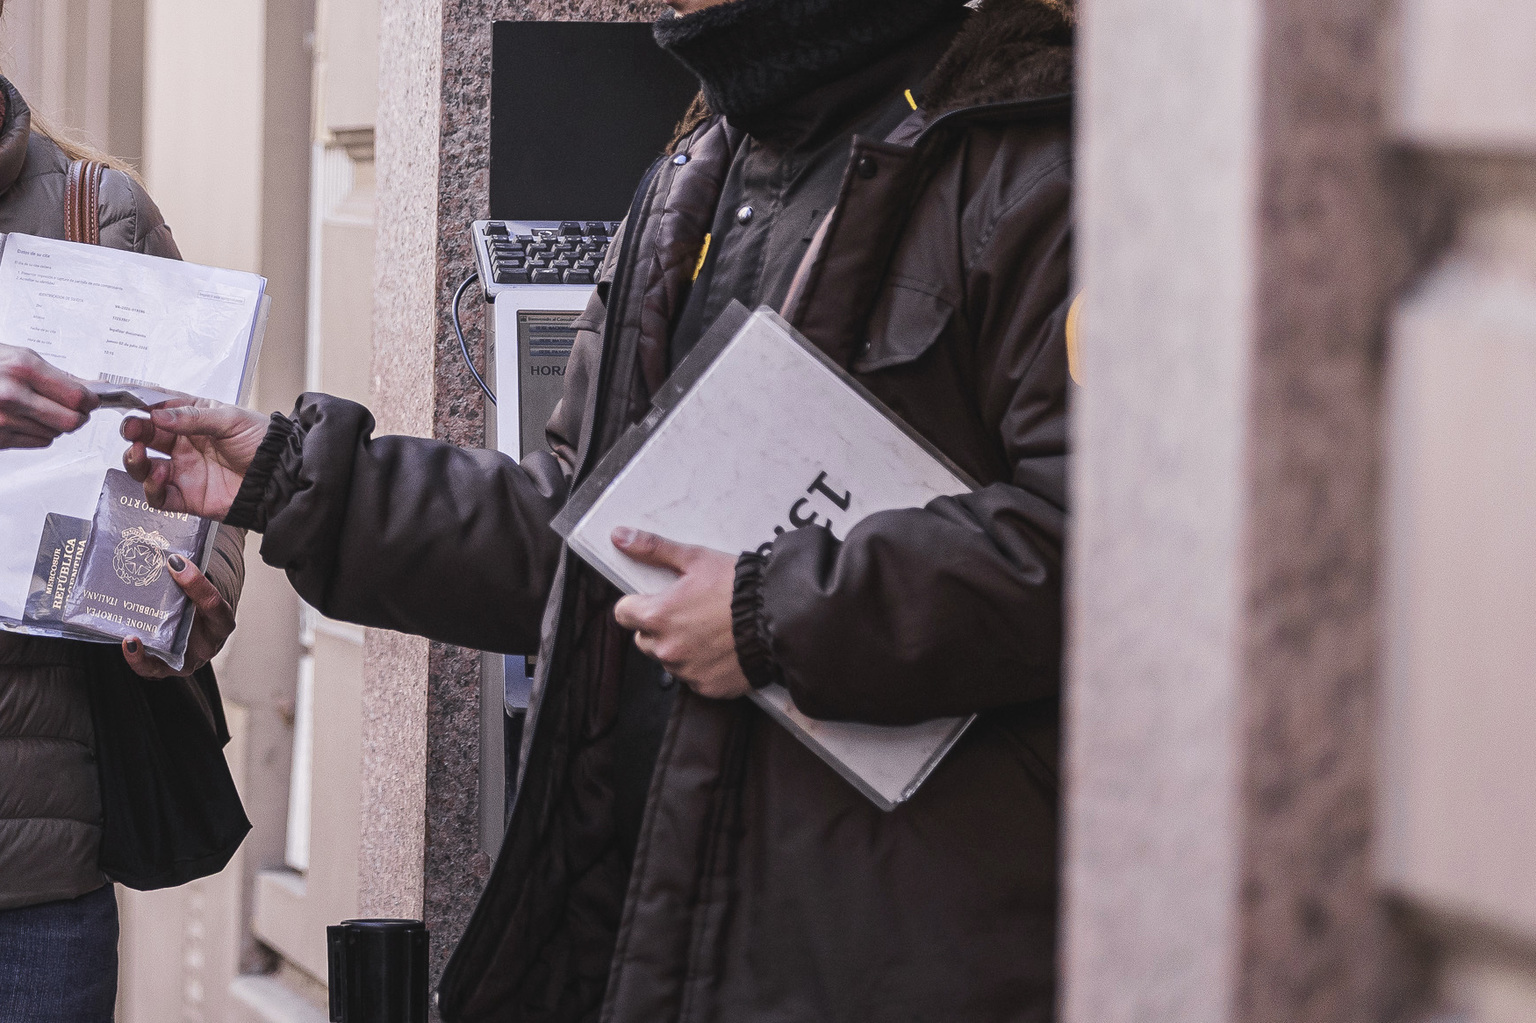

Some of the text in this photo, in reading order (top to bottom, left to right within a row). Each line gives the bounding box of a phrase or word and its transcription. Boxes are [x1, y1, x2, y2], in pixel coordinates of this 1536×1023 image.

[45, 548, 61, 595] MERCOSUR
[52, 538, 77, 610] REPÚBLICA
[82, 589, 119, 607] ITALIANA
[85, 606, 159, 633] UNIONE EUROPEA
